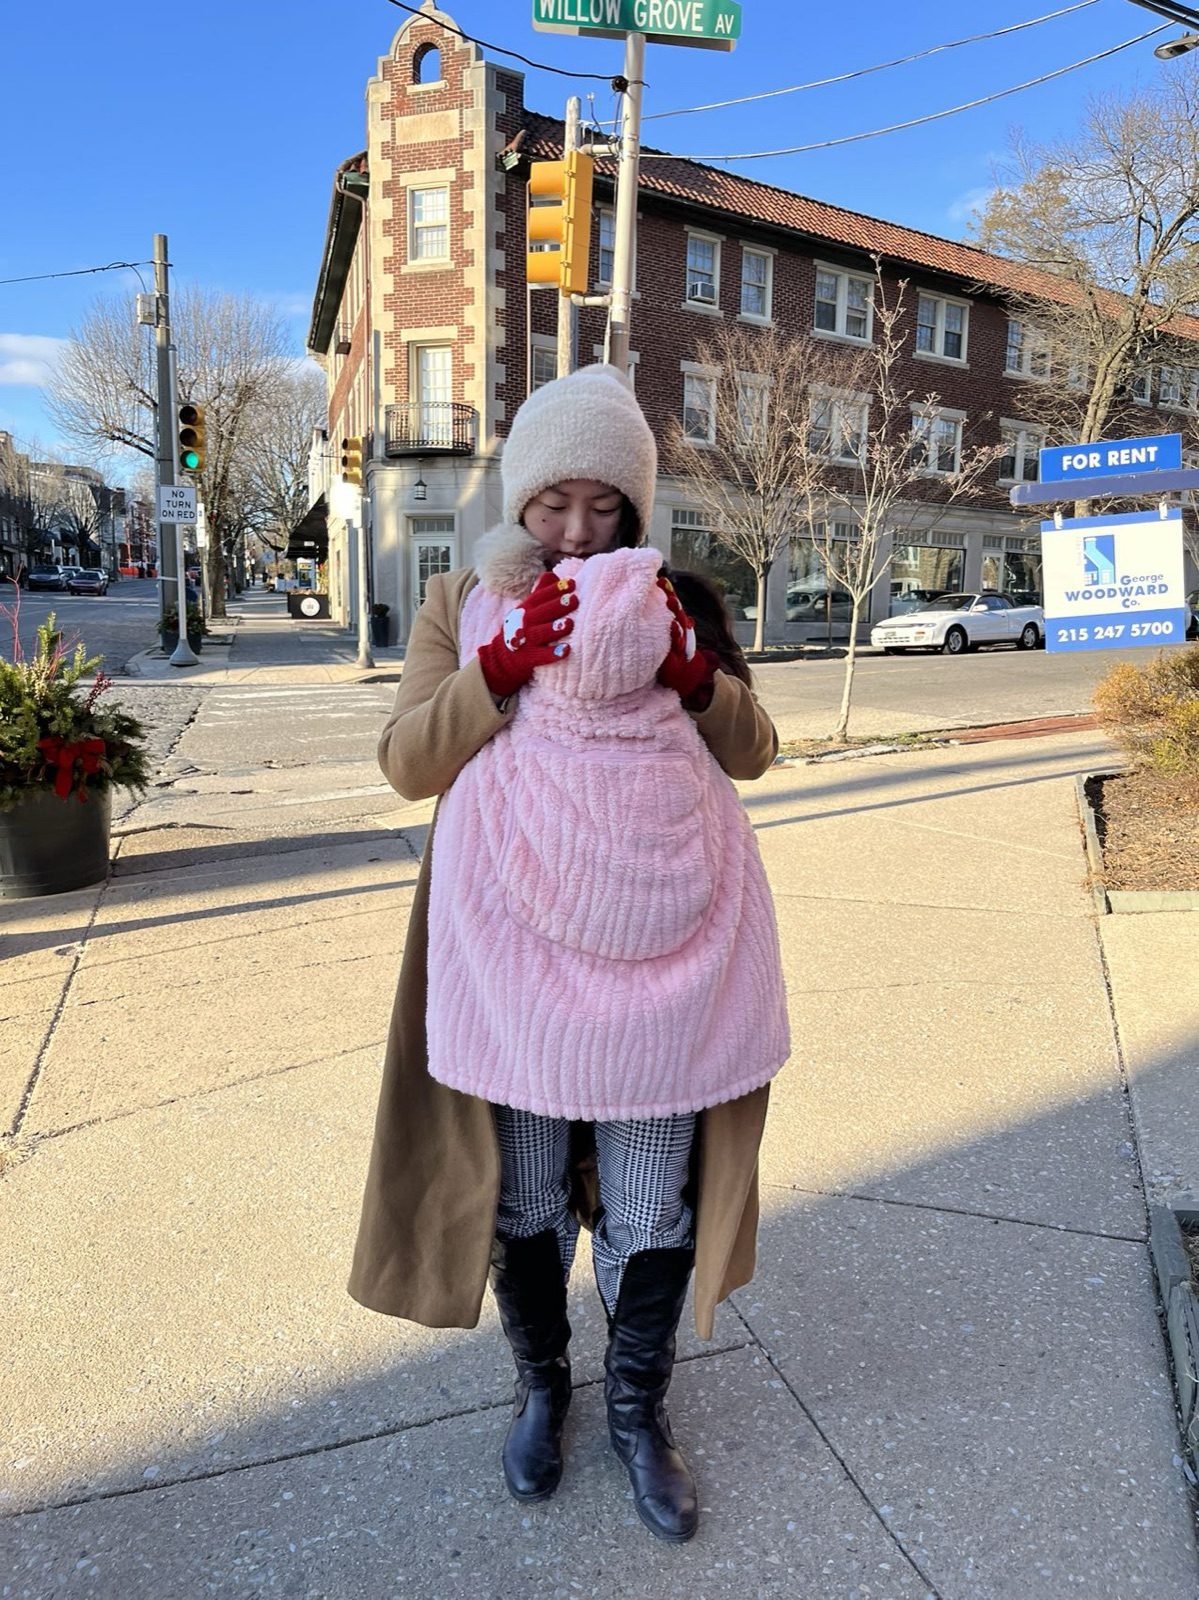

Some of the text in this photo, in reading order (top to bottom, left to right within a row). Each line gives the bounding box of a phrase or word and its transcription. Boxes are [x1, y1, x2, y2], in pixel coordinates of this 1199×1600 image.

[540, 0, 735, 34] WILLOW GROVE AV
[1061, 446, 1159, 471] FOR RENT
[172, 490, 185, 498] NO
[166, 500, 191, 508] TURN
[178, 510, 195, 519] RED
[1120, 573, 1164, 585] George
[1064, 583, 1169, 602] WOODWARD
[1121, 598, 1141, 609] Co.
[1057, 620, 1174, 643] 215 247 5700
